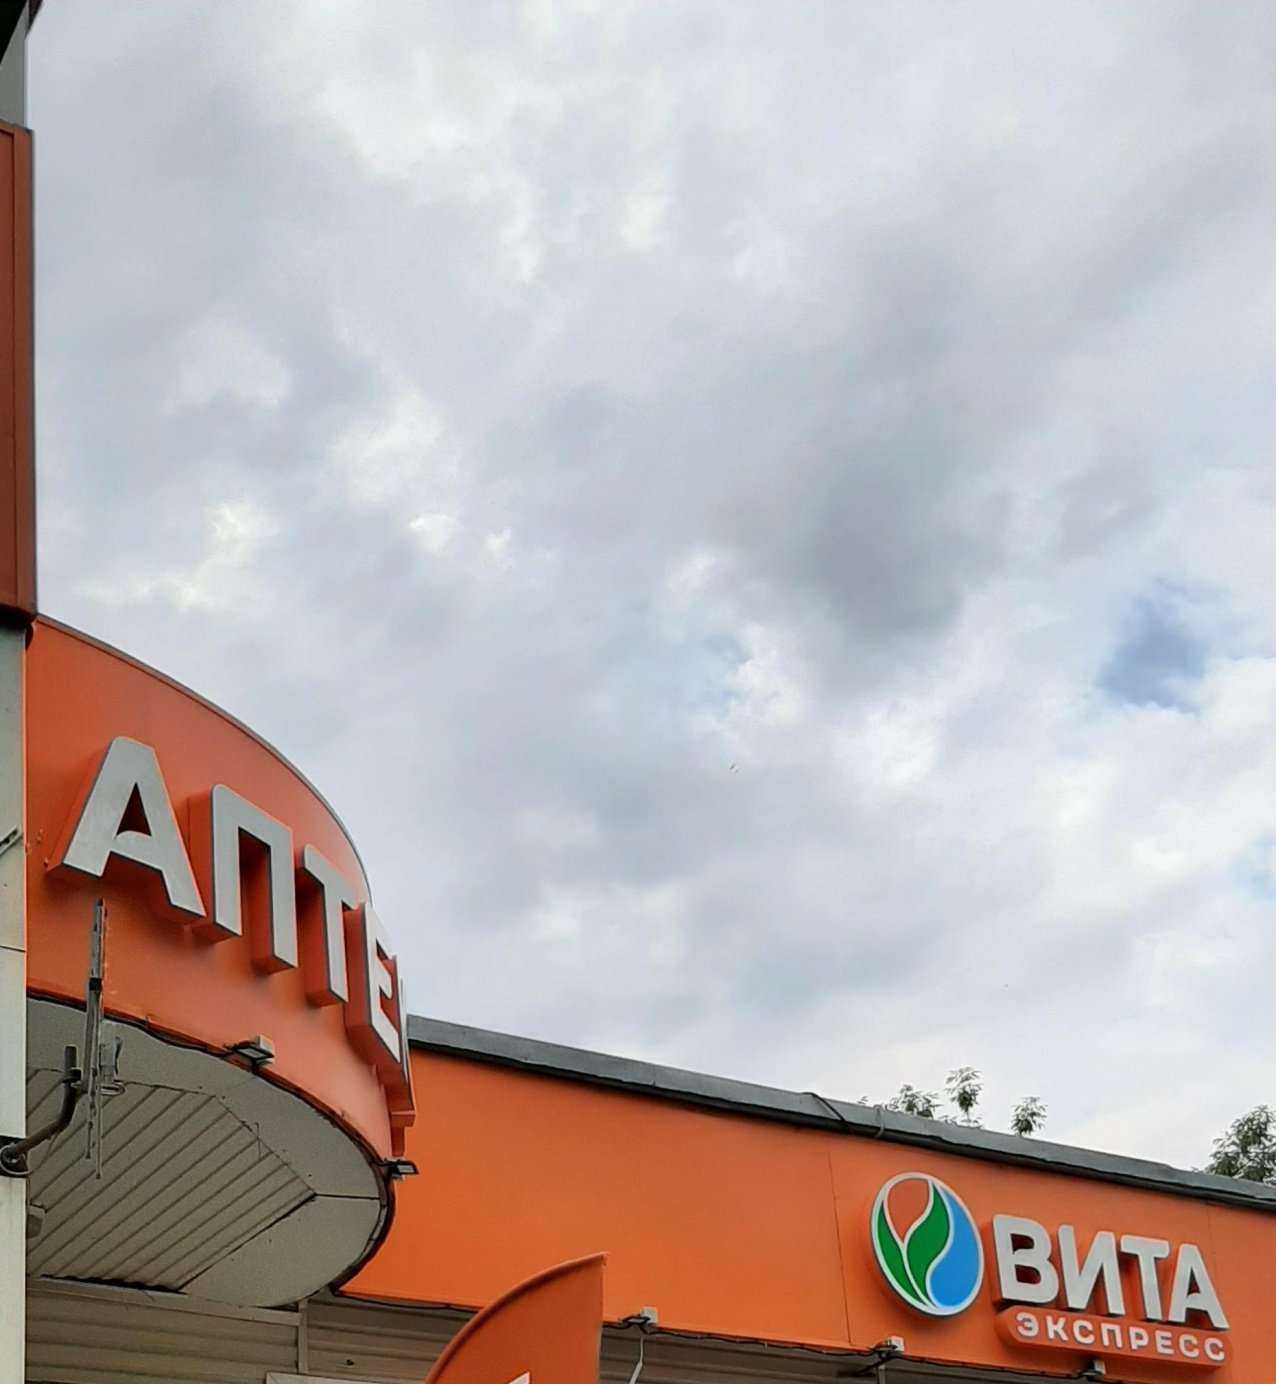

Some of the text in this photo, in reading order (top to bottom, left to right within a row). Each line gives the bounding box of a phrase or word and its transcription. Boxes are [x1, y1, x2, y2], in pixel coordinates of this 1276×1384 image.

[62, 736, 408, 1086] АПТЕ
[993, 1214, 1230, 1329] ВИТА
[1016, 1312, 1225, 1361] ЭКСПРЕСС
